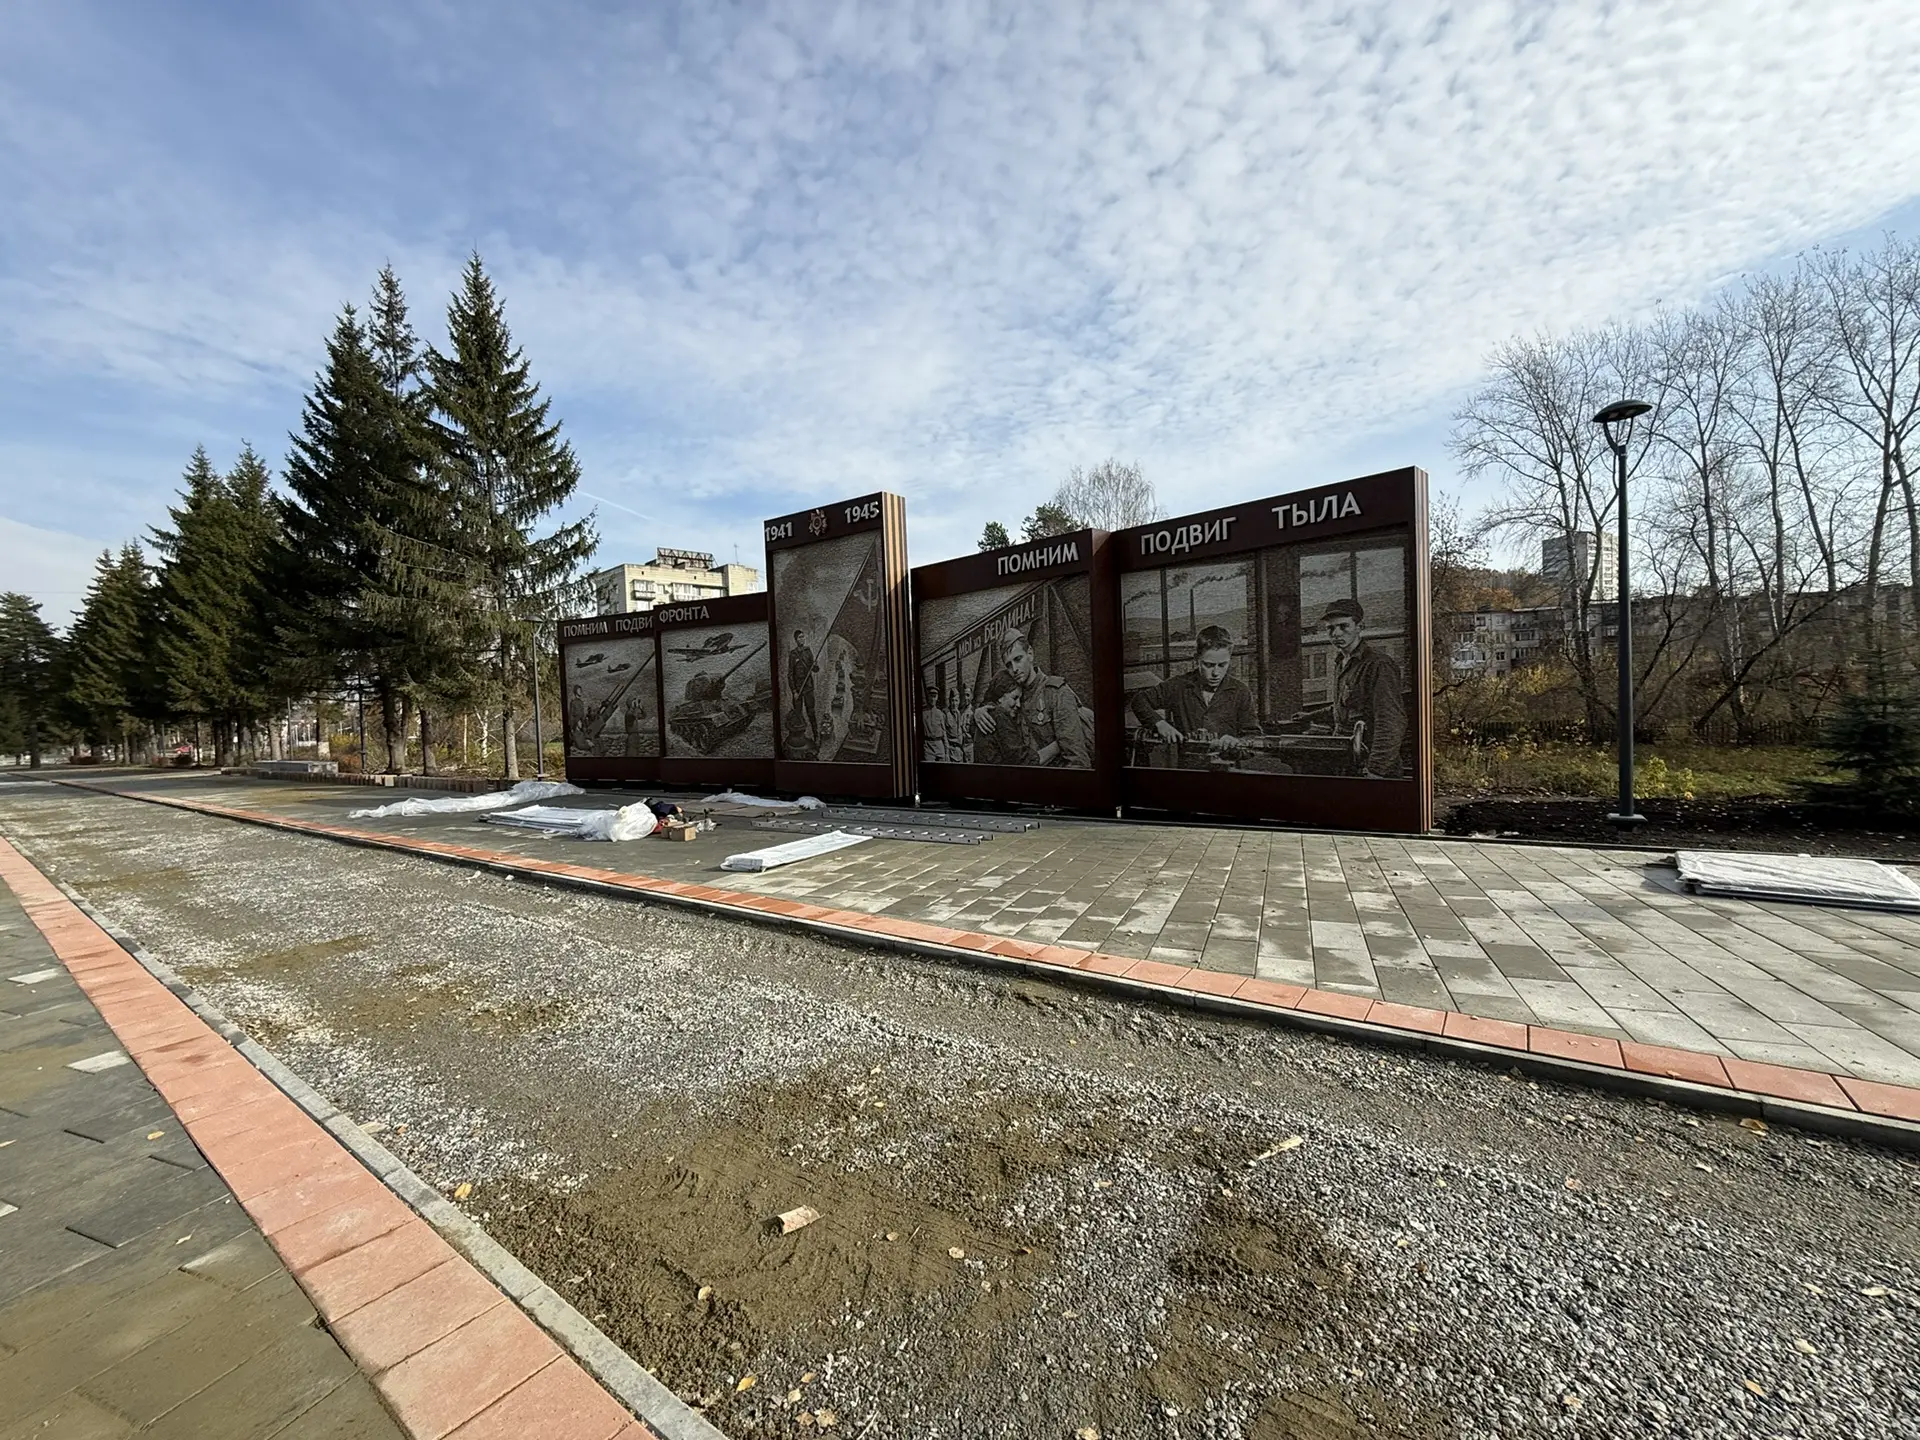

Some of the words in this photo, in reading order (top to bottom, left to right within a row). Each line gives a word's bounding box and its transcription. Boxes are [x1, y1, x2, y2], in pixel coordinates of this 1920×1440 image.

[765, 521, 793, 542] 1941
[844, 501, 880, 524] 1945
[997, 541, 1079, 576] ПОМНИМ
[1140, 516, 1237, 556] ПОДВИГ
[1271, 491, 1362, 529] ТЫЛА
[563, 620, 608, 638] ПОМНИМ
[615, 616, 654, 633] ПОДВИ
[659, 605, 710, 624] ФРОНТА
